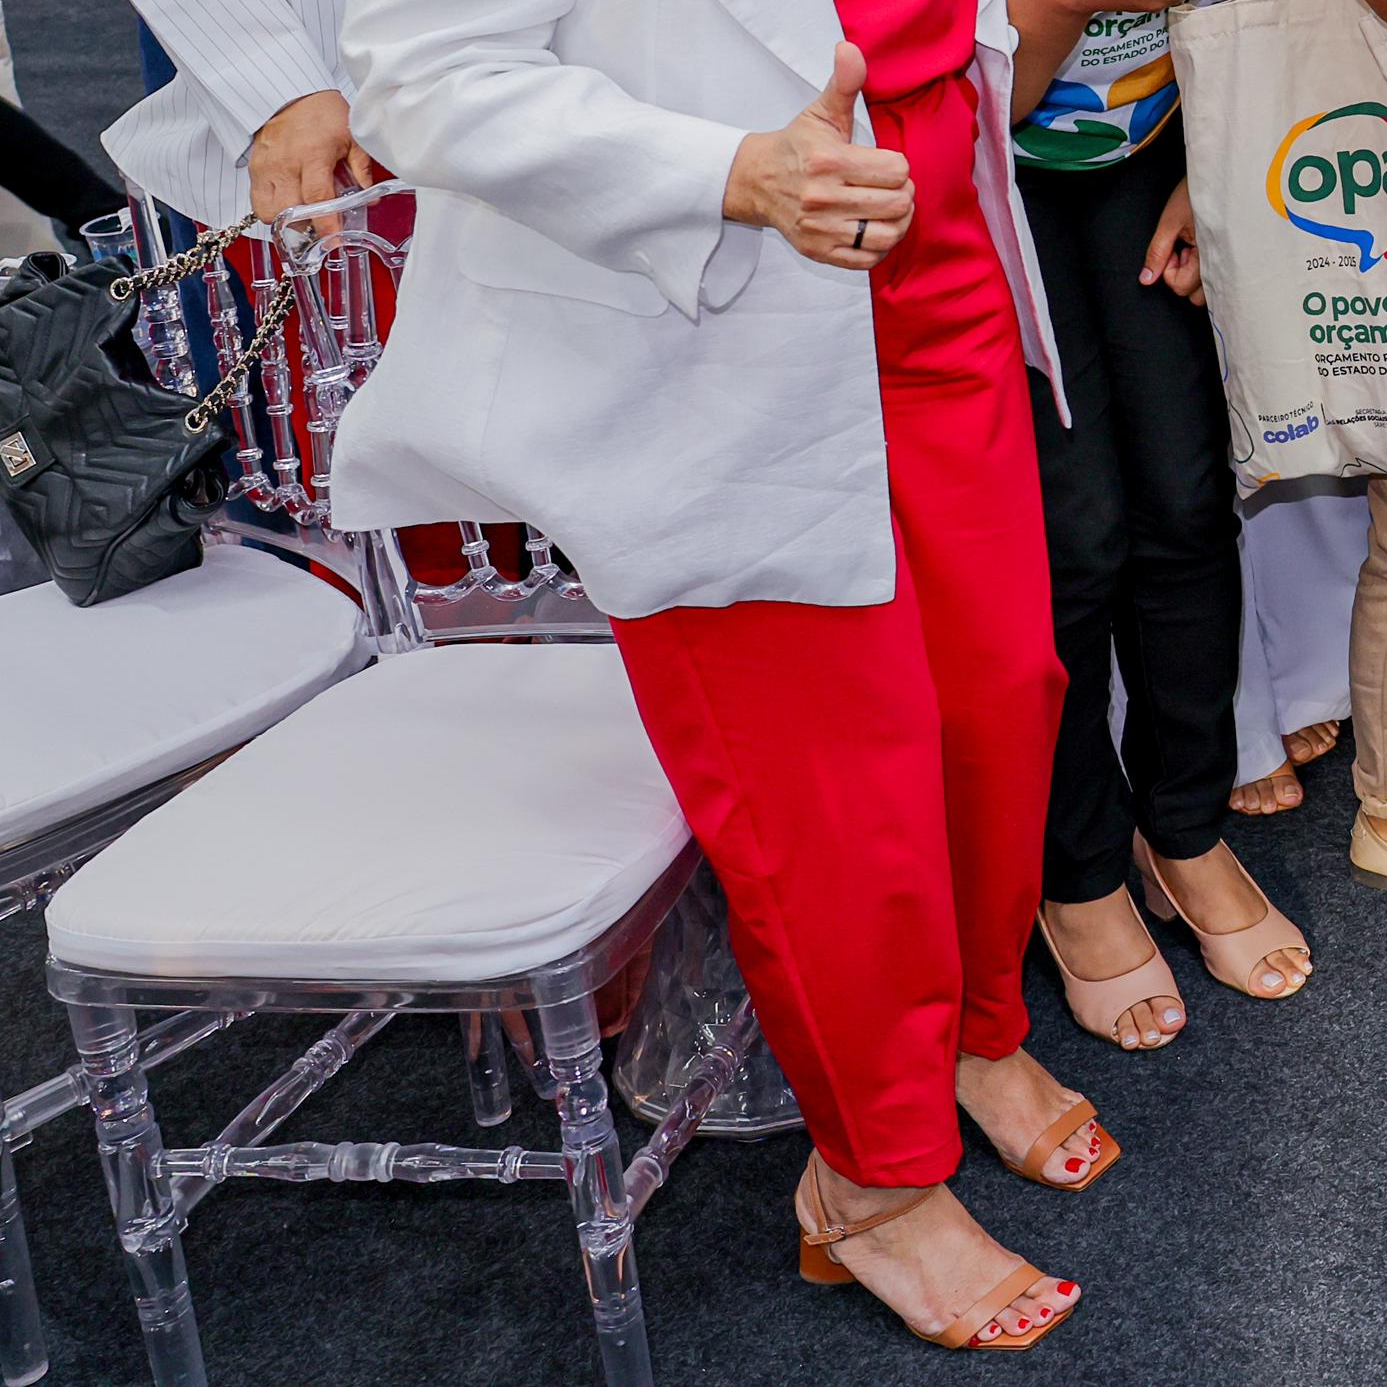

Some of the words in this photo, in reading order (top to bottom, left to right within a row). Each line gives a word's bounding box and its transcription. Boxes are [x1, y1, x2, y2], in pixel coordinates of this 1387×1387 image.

[1080, 58, 1100, 67] DO
[1102, 47, 1148, 65] ESTADO
[1150, 39, 1165, 51] DO
[1081, 32, 1155, 58] ORÇAMENTO
[1306, 256, 1330, 270] 2024
[1302, 292, 1327, 315] O
[1314, 353, 1381, 365] ORÇAMENTO
[1332, 365, 1376, 377] ESTADO
[1258, 414, 1290, 423] PARCEIRO
[1263, 415, 1319, 443] colab
